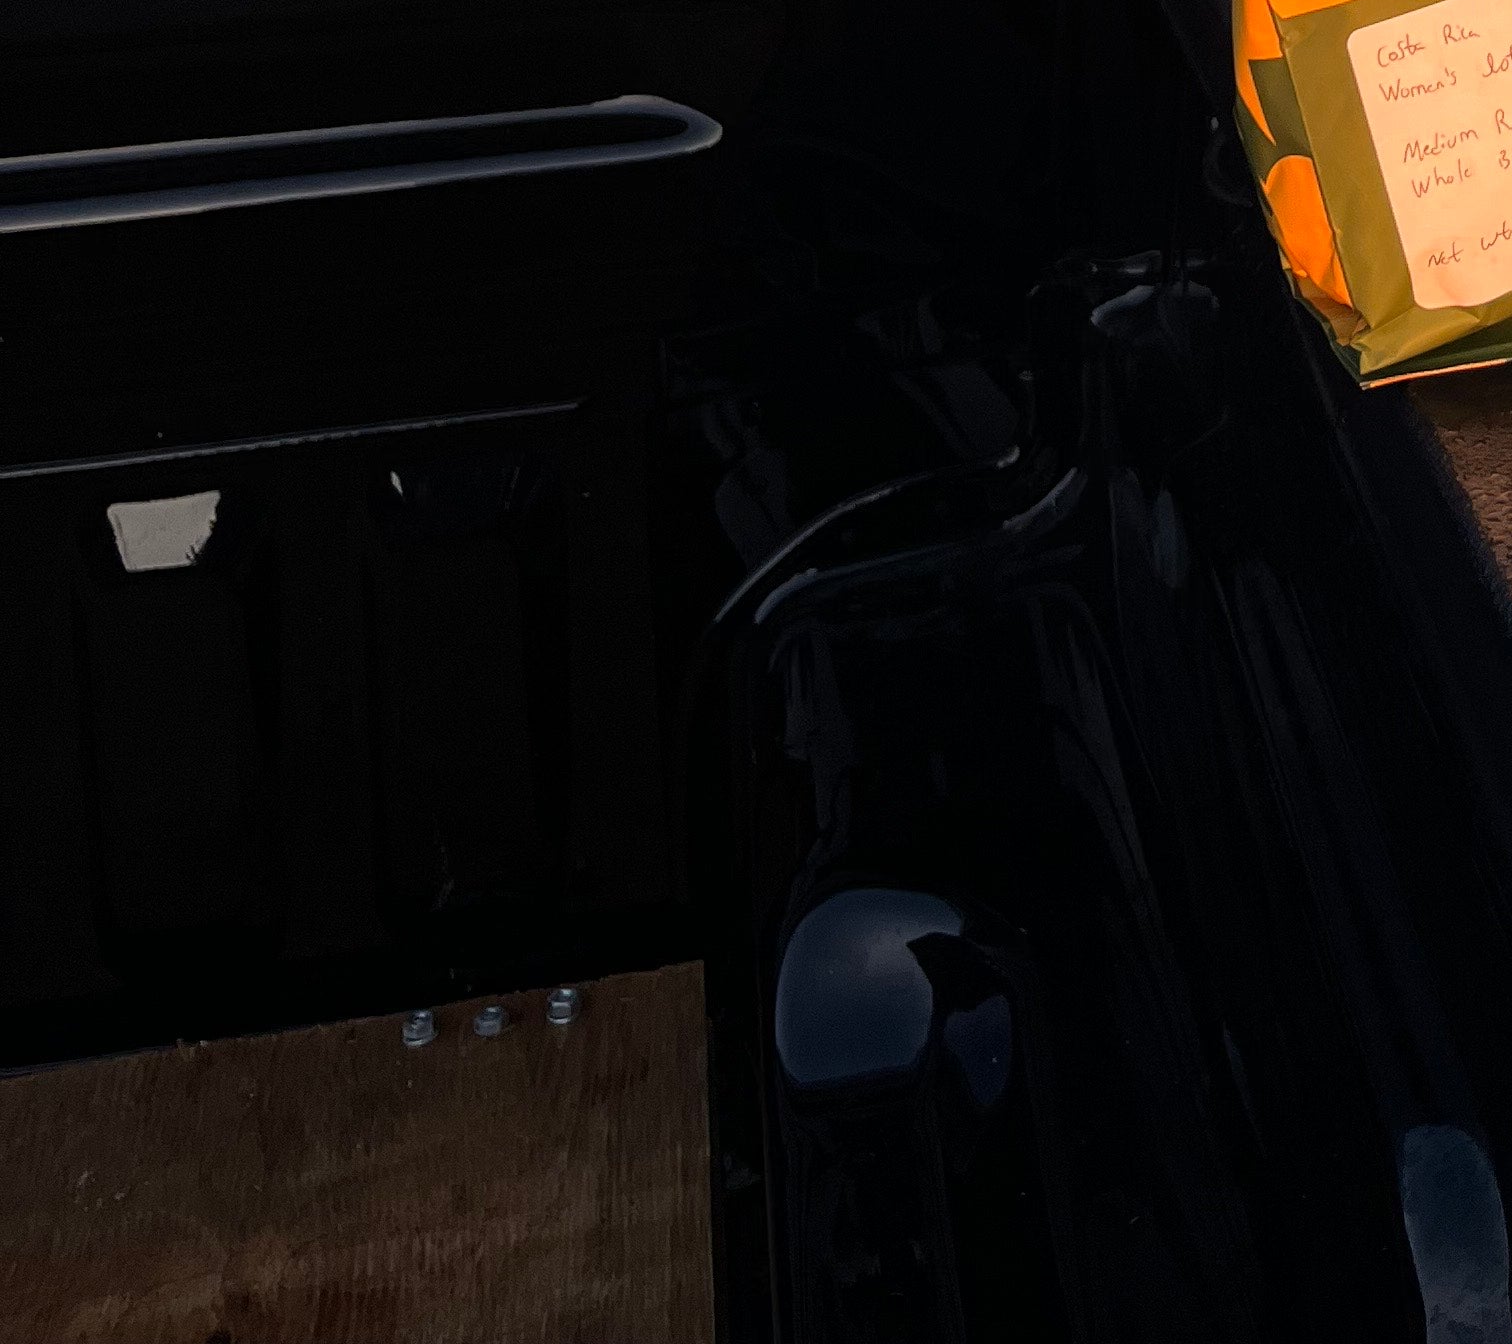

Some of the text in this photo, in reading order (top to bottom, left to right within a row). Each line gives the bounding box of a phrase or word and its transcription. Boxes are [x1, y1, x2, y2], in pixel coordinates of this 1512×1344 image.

[1377, 23, 1481, 68] Costa Rica
[1378, 67, 1457, 102] Women's
[1403, 129, 1479, 163] Medium
[1411, 158, 1472, 198] Whole
